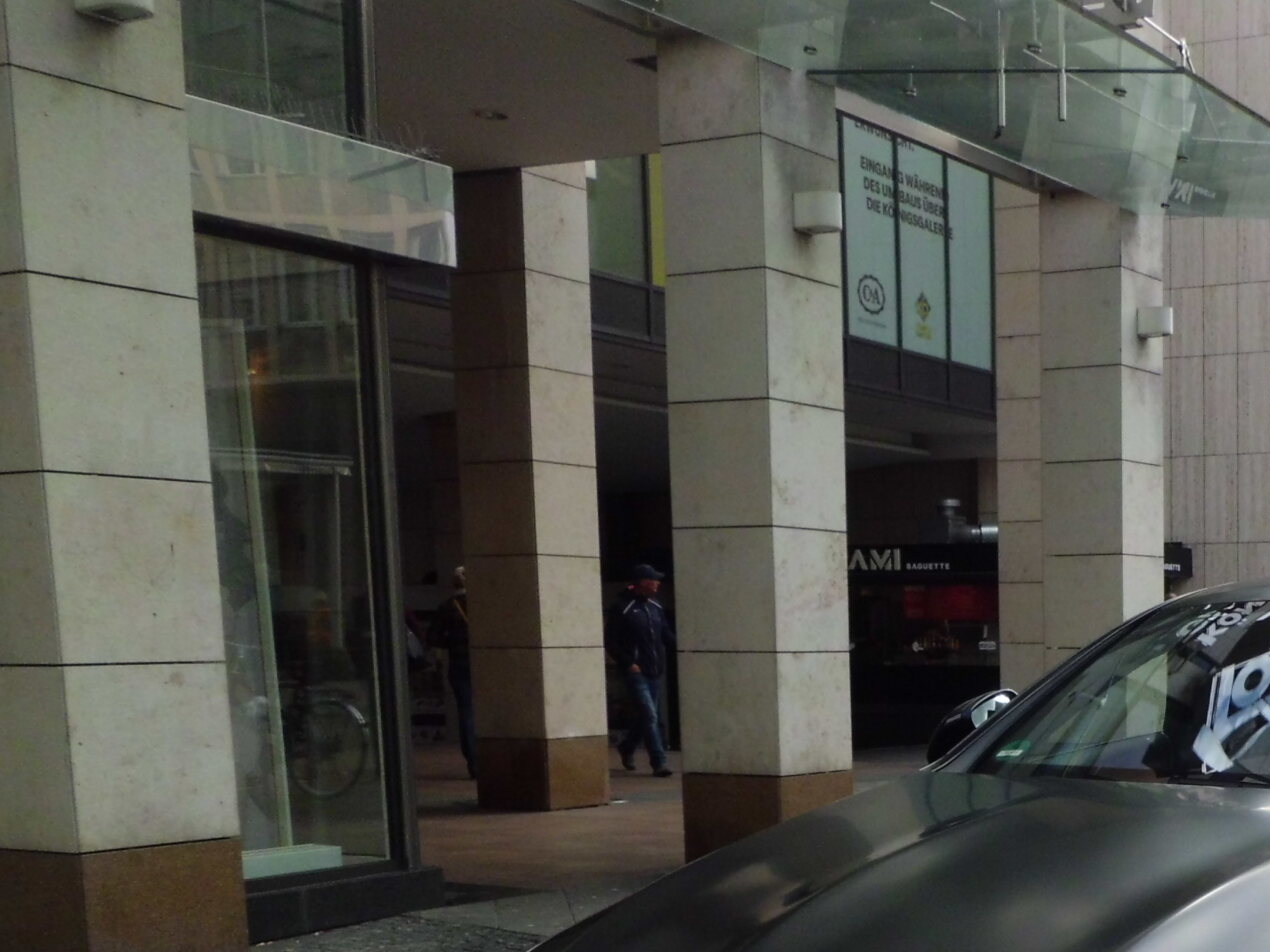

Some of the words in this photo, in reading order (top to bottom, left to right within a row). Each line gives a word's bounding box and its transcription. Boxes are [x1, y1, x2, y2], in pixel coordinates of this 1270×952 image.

[860, 155, 904, 184] EINGANG
[863, 176, 880, 193] DES
[882, 183, 921, 209] UMBAUS
[922, 195, 946, 218] ÜBER
[866, 197, 881, 213] DIE
[882, 201, 953, 240] KÖNIGSGALERE
[906, 562, 951, 571] BAGUETTE
